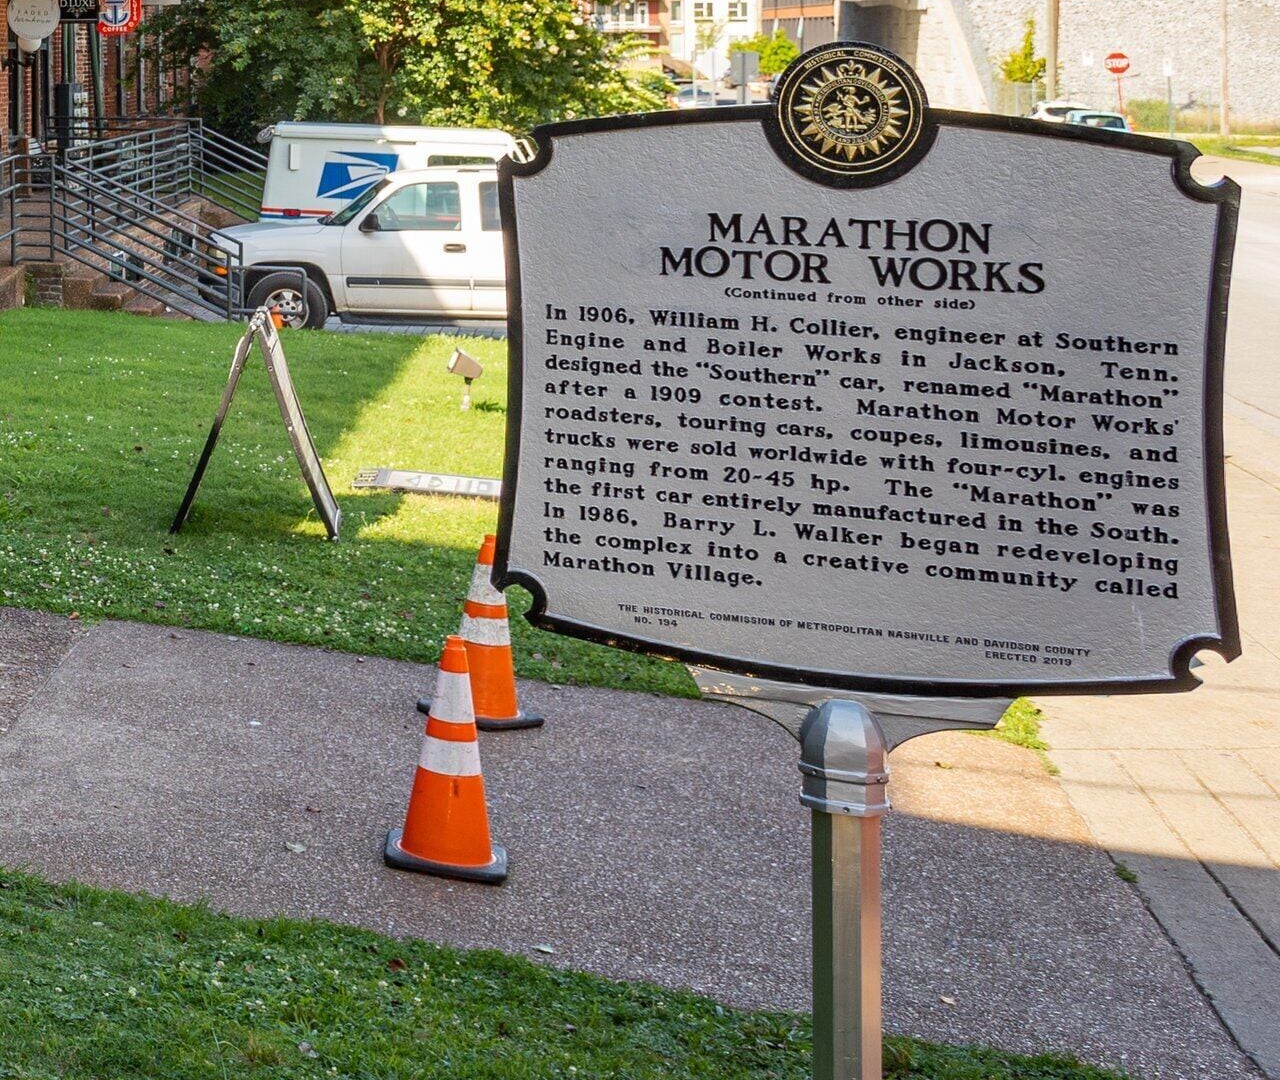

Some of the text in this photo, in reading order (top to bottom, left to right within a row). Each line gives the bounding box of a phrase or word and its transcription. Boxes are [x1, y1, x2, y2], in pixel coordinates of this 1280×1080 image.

[804, 51, 899, 72] HISTORICAL COMMISSION
[1105, 58, 1129, 68] STOP
[708, 214, 992, 253] MARATHON
[660, 247, 1044, 293] MOTOR WORKS
[827, 292, 866, 304] from
[877, 295, 923, 307] other
[546, 304, 1177, 354] In 1906, William H. Collier, engineer at Southern
[546, 355, 641, 375] designed
[651, 361, 688, 378] the
[840, 377, 885, 393] car,
[903, 381, 1013, 399] renamed
[547, 330, 1177, 381] Engine and Boiler Works in Jackson, Tenn.
[545, 380, 608, 397] after
[624, 388, 636, 399] a
[651, 386, 701, 403] 1909
[720, 394, 821, 411] contest.
[857, 400, 978, 422] Marathon
[997, 409, 1074, 428] Motor
[545, 429, 1178, 488] trucks were sold worldwide with four-cyl. engines
[546, 407, 1178, 463] roadsters, touring cars, coupes, limousines, and
[544, 478, 1178, 543] the first car entirely manufactured in the South.
[545, 458, 633, 477] ranging
[650, 462, 707, 480] from
[812, 475, 849, 494] hp.
[885, 480, 932, 497] The
[1131, 503, 1179, 517] was
[543, 527, 1178, 598] the complex into a creative community called
[544, 502, 1177, 575] In 1986, Barry L. Walker began redeveloping
[544, 551, 761, 587] Marathon Village.
[618, 604, 638, 612] THE
[643, 606, 705, 619] HISTORICAL
[710, 613, 775, 626] COMMISSION
[797, 621, 882, 636] METROPOLITAN
[888, 630, 950, 643] NASHVILLE
[955, 637, 978, 646] AND
[984, 639, 1040, 652] DAVIDSON
[1045, 646, 1091, 657] COUNTY
[634, 616, 678, 627] NO. 194
[985, 651, 1072, 666] ERECTED 2019
